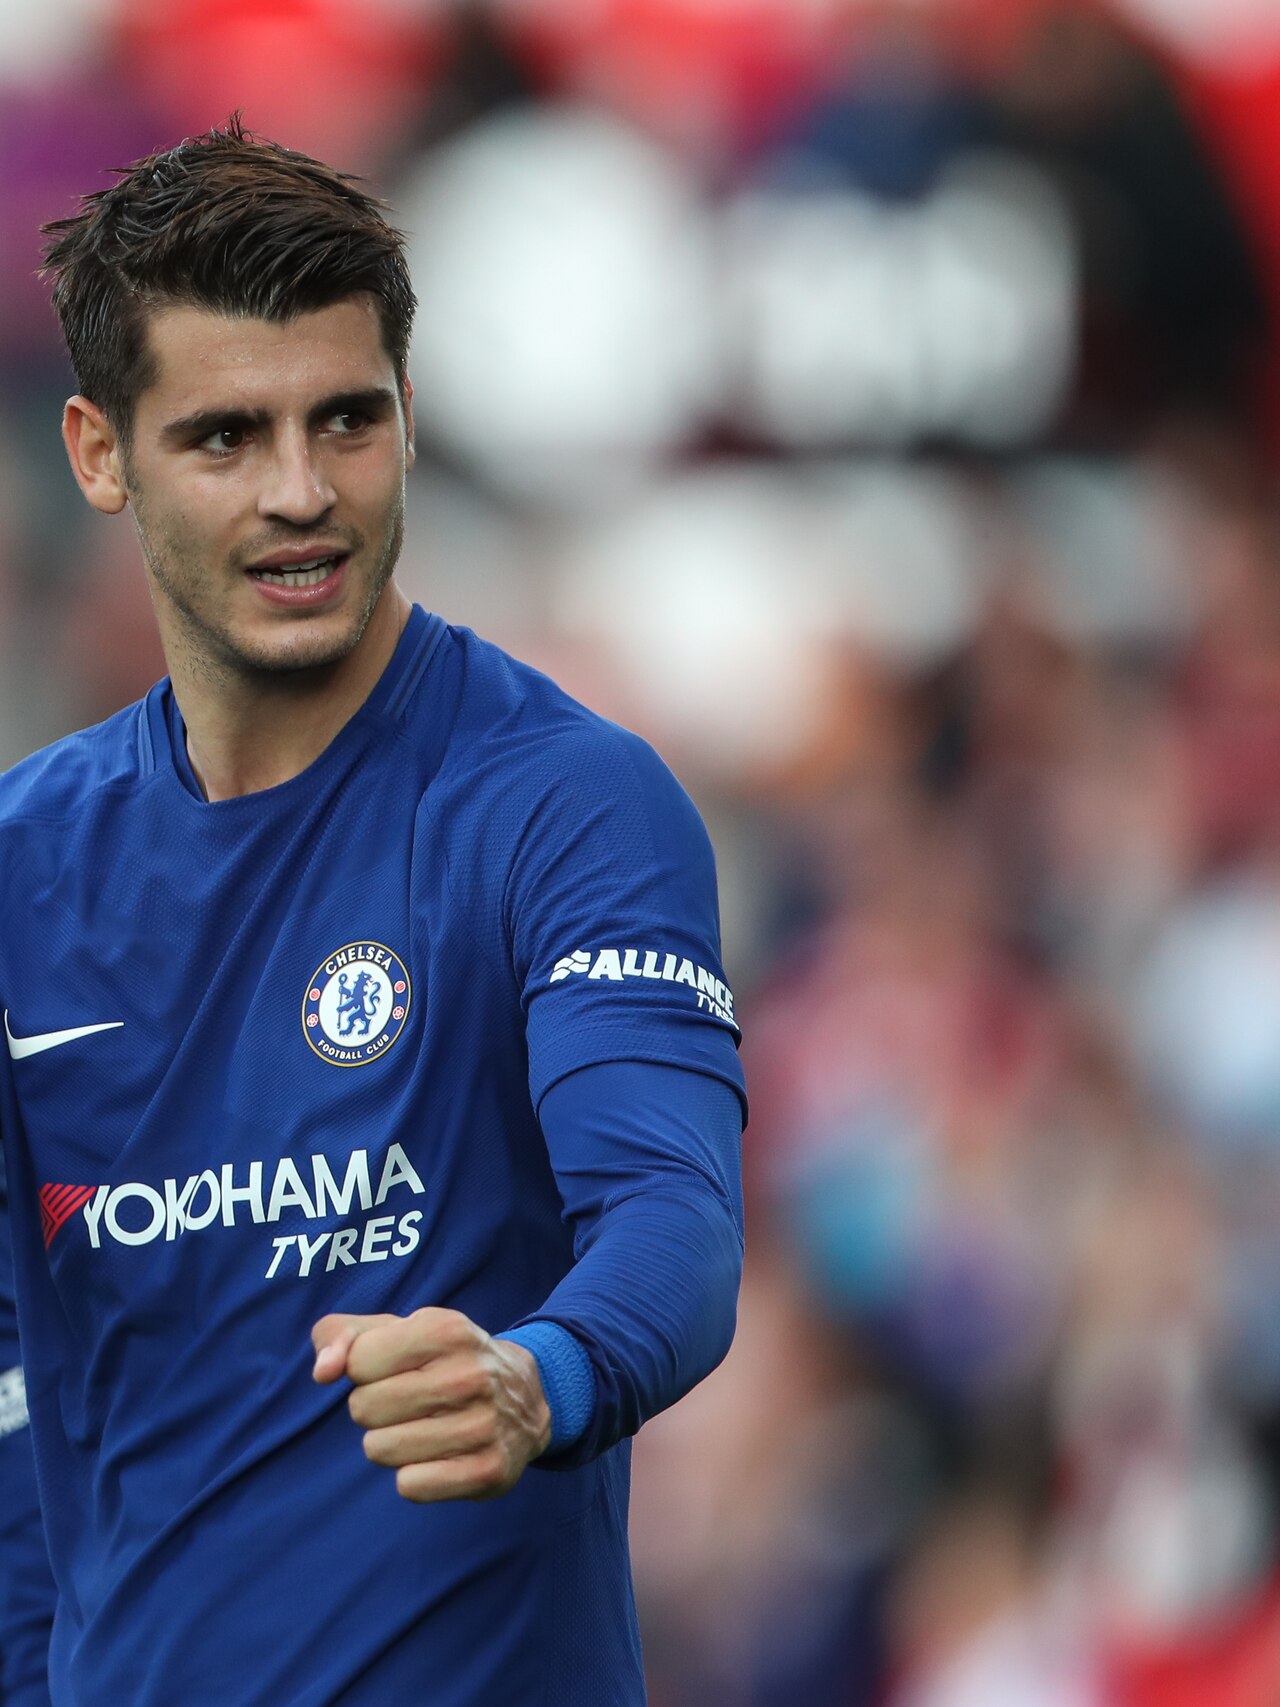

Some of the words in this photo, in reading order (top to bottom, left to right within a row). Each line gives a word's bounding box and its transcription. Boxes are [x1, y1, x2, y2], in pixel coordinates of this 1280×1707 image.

[325, 946, 393, 975] CHELSEA
[587, 949, 734, 1019] ALLIANCE
[318, 1039, 363, 1060] FOOTBALL
[366, 1033, 390, 1055] CLUB
[83, 1143, 425, 1249] YOKOHAMA
[264, 1211, 424, 1280] TYRES
